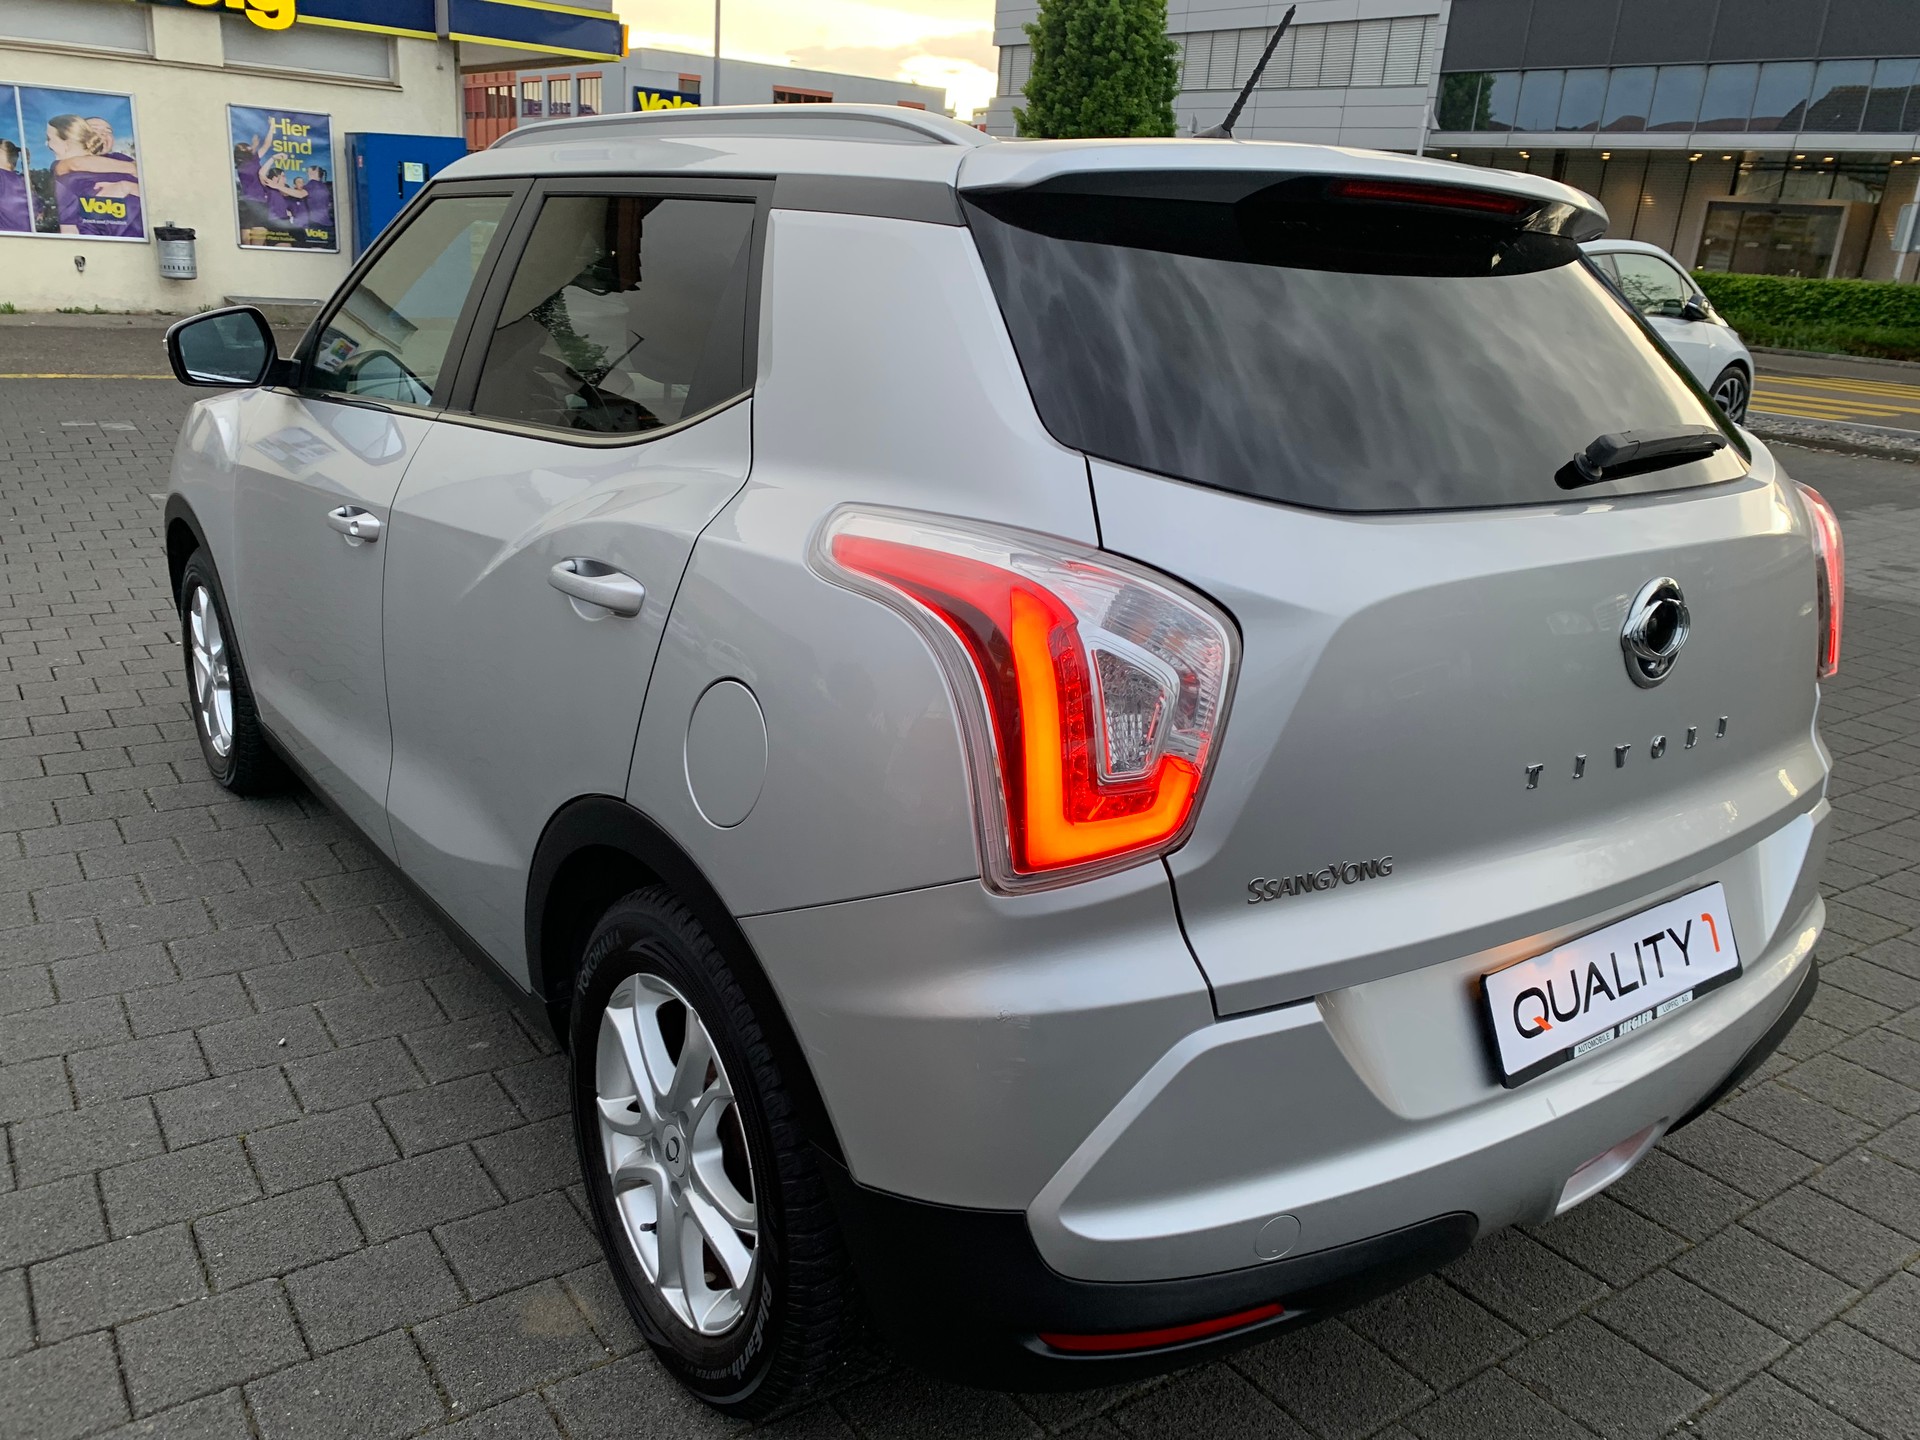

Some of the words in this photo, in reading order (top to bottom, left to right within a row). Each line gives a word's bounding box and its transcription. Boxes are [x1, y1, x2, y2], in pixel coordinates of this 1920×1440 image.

[637, 91, 698, 111] Vol
[270, 117, 310, 137] Hier
[272, 136, 312, 155] sind
[274, 154, 306, 171] wir.
[80, 198, 126, 218] Volg
[305, 229, 328, 239] Volg
[1526, 716, 1728, 789] TIVOLI
[577, 929, 623, 996] YOKOHAMA
[1513, 919, 1692, 1039] QUALITY
[1701, 913, 1720, 953] 1
[1578, 1033, 1611, 1053] AUTOMOBILE
[1618, 1011, 1653, 1036] SIEGLER
